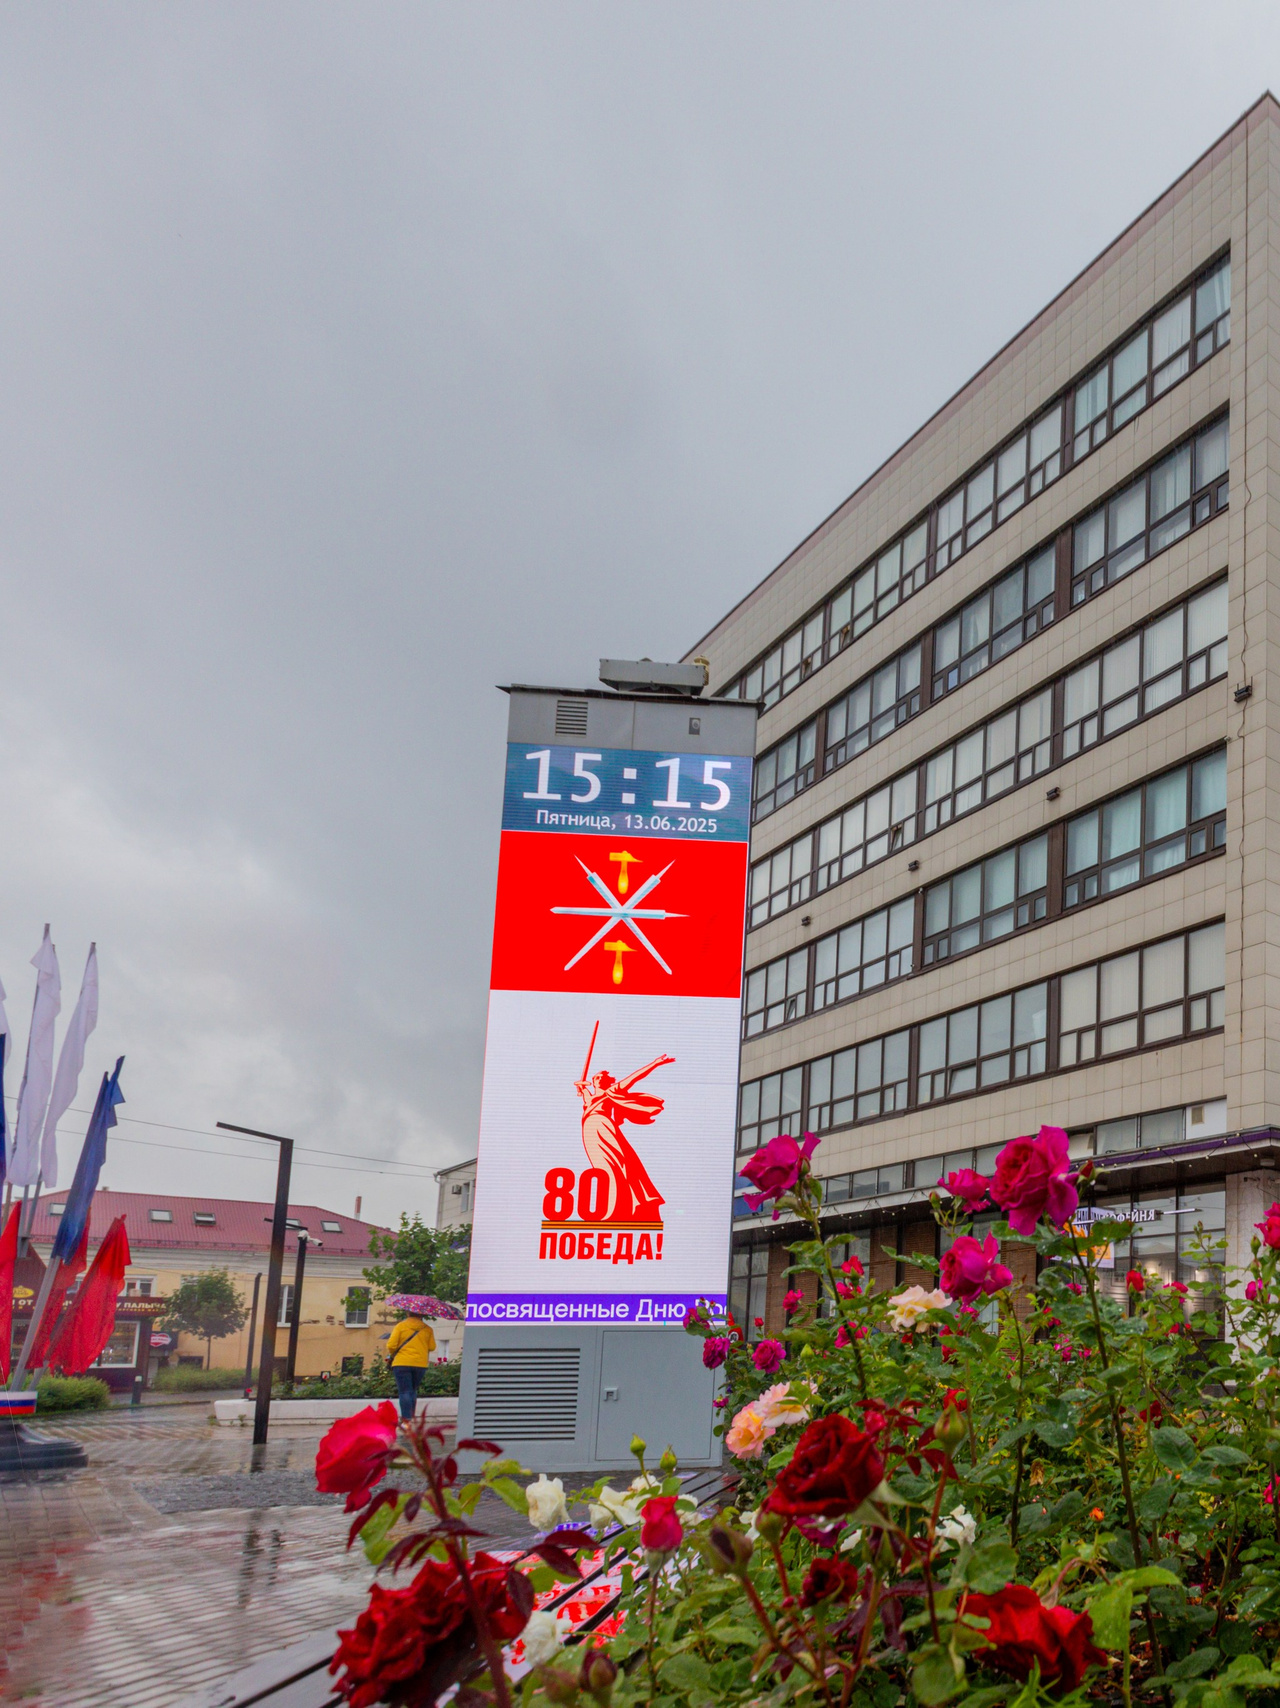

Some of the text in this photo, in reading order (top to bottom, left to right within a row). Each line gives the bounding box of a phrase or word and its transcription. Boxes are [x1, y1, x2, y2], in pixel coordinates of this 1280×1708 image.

[523, 749, 732, 811] 15:15
[536, 809, 718, 833] Пятница, 13.06.2025
[542, 1167, 611, 1221] 80
[539, 1232, 664, 1265] ПОБЕДА!
[465, 1302, 630, 1322] посвященные
[635, 1298, 686, 1322] Дню
